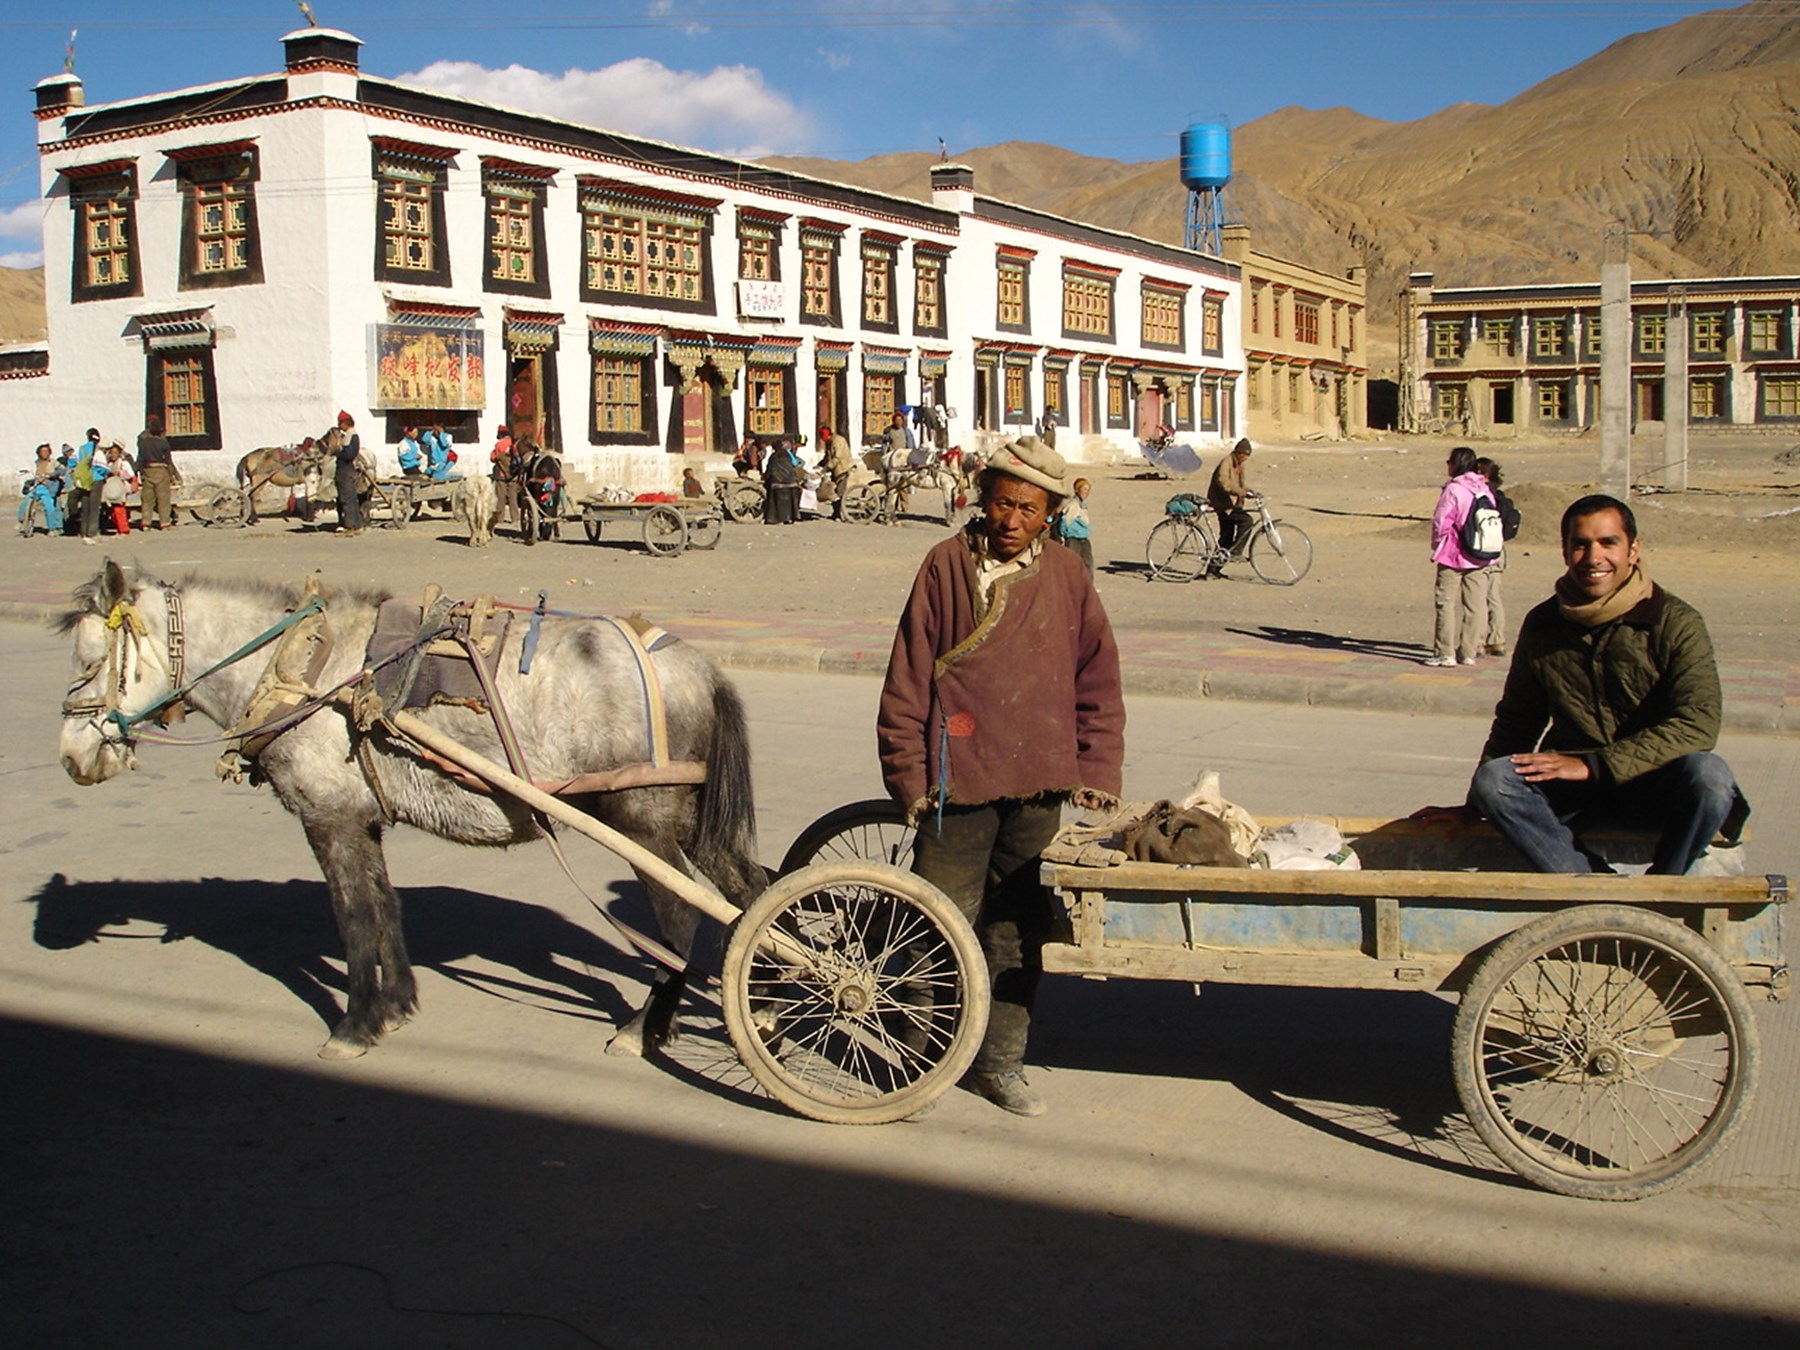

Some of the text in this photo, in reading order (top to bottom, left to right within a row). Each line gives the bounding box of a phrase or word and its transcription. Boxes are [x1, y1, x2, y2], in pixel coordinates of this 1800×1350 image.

[380, 351, 482, 382] 珠峰批发部
